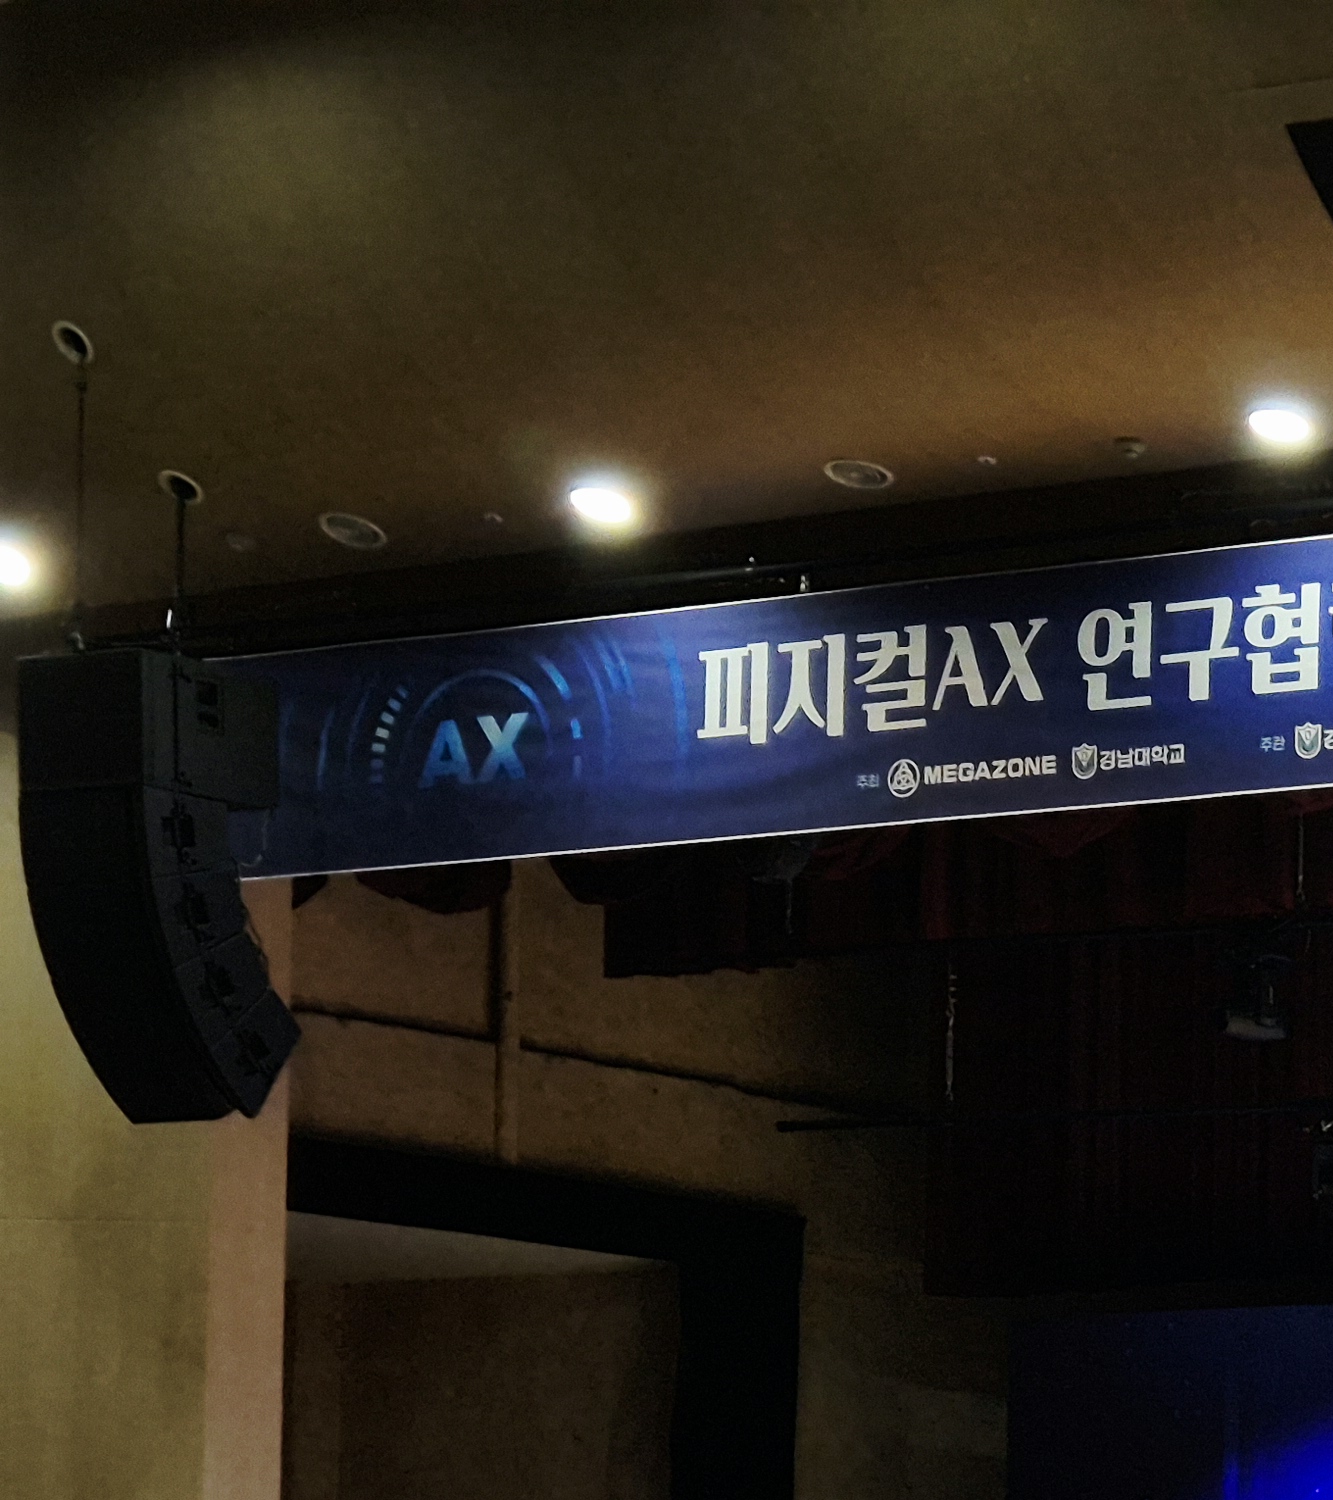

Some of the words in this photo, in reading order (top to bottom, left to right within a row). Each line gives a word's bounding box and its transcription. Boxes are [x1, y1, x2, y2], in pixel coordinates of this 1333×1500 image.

[696, 617, 1049, 746] 피지컬AX
[418, 711, 528, 790] AX
[923, 755, 1057, 786] MEGAZONE
[1099, 743, 1186, 772] 경남대학교
[1259, 735, 1286, 752] 주관
